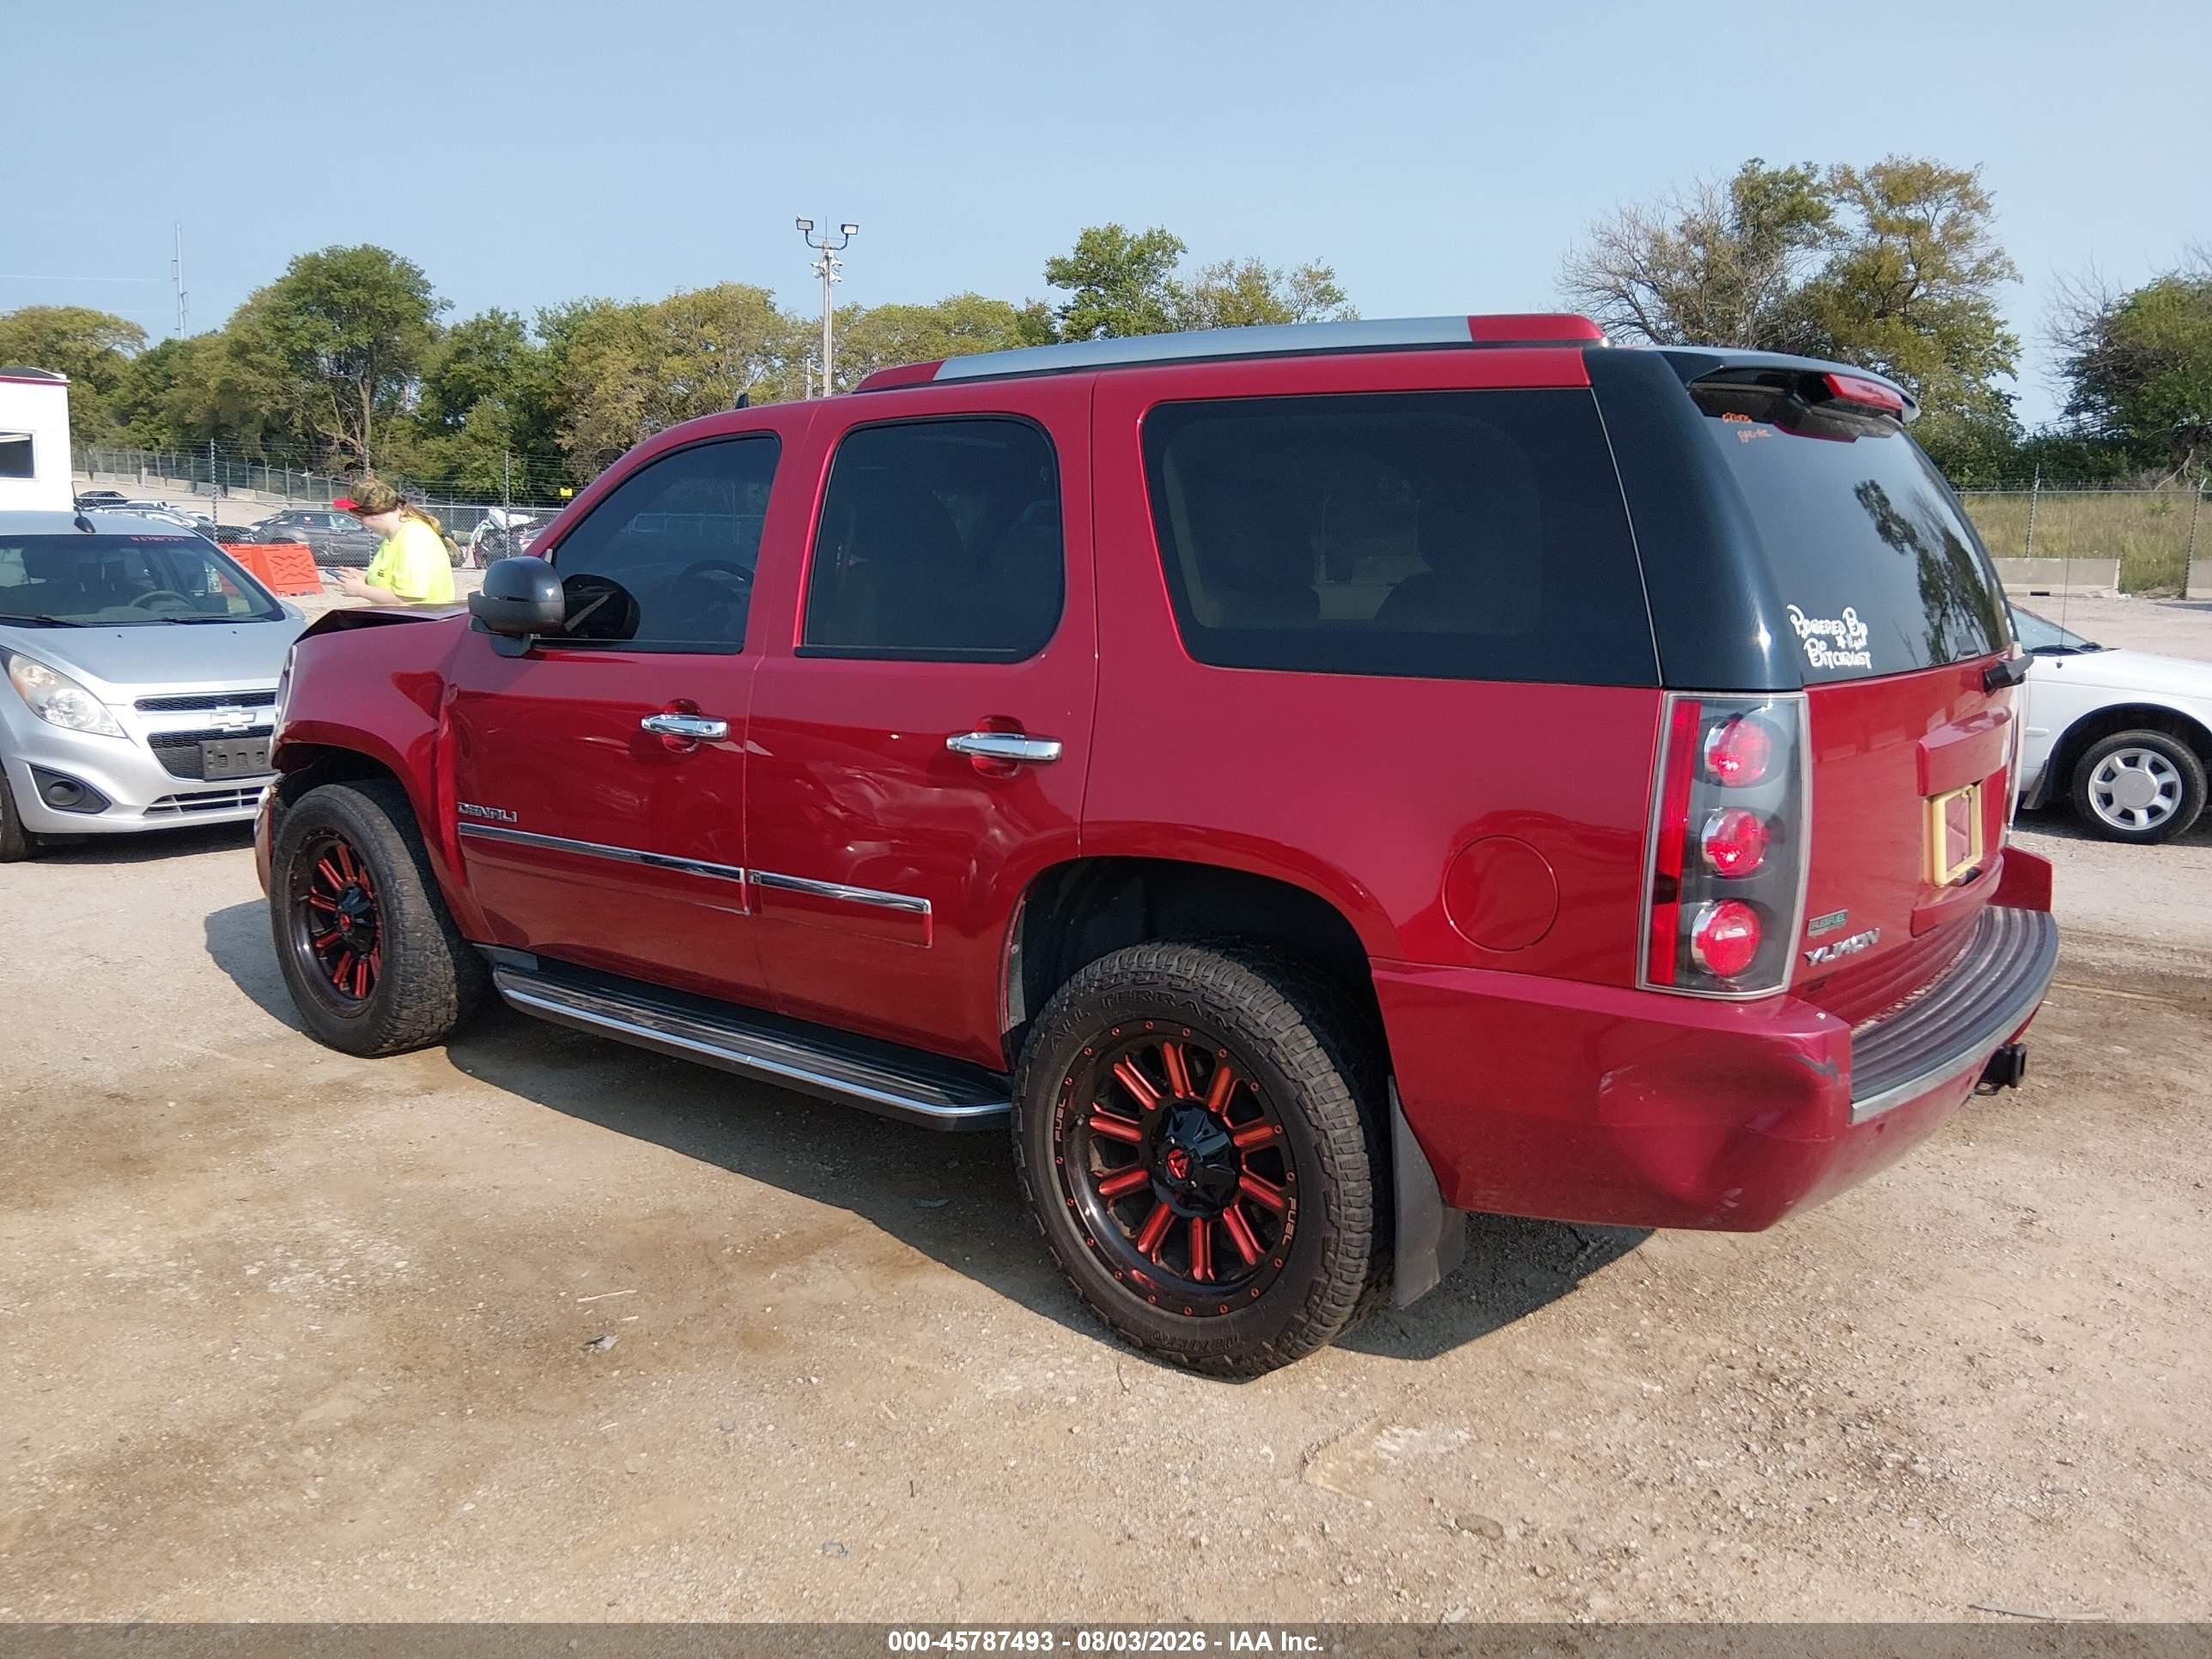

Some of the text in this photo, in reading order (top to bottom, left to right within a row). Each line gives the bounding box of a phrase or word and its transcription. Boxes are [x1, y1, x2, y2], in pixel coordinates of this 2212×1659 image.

[457, 801, 518, 823] DENALI
[1803, 927, 1881, 967] YUKON
[1282, 1196, 1297, 1245] FUEL
